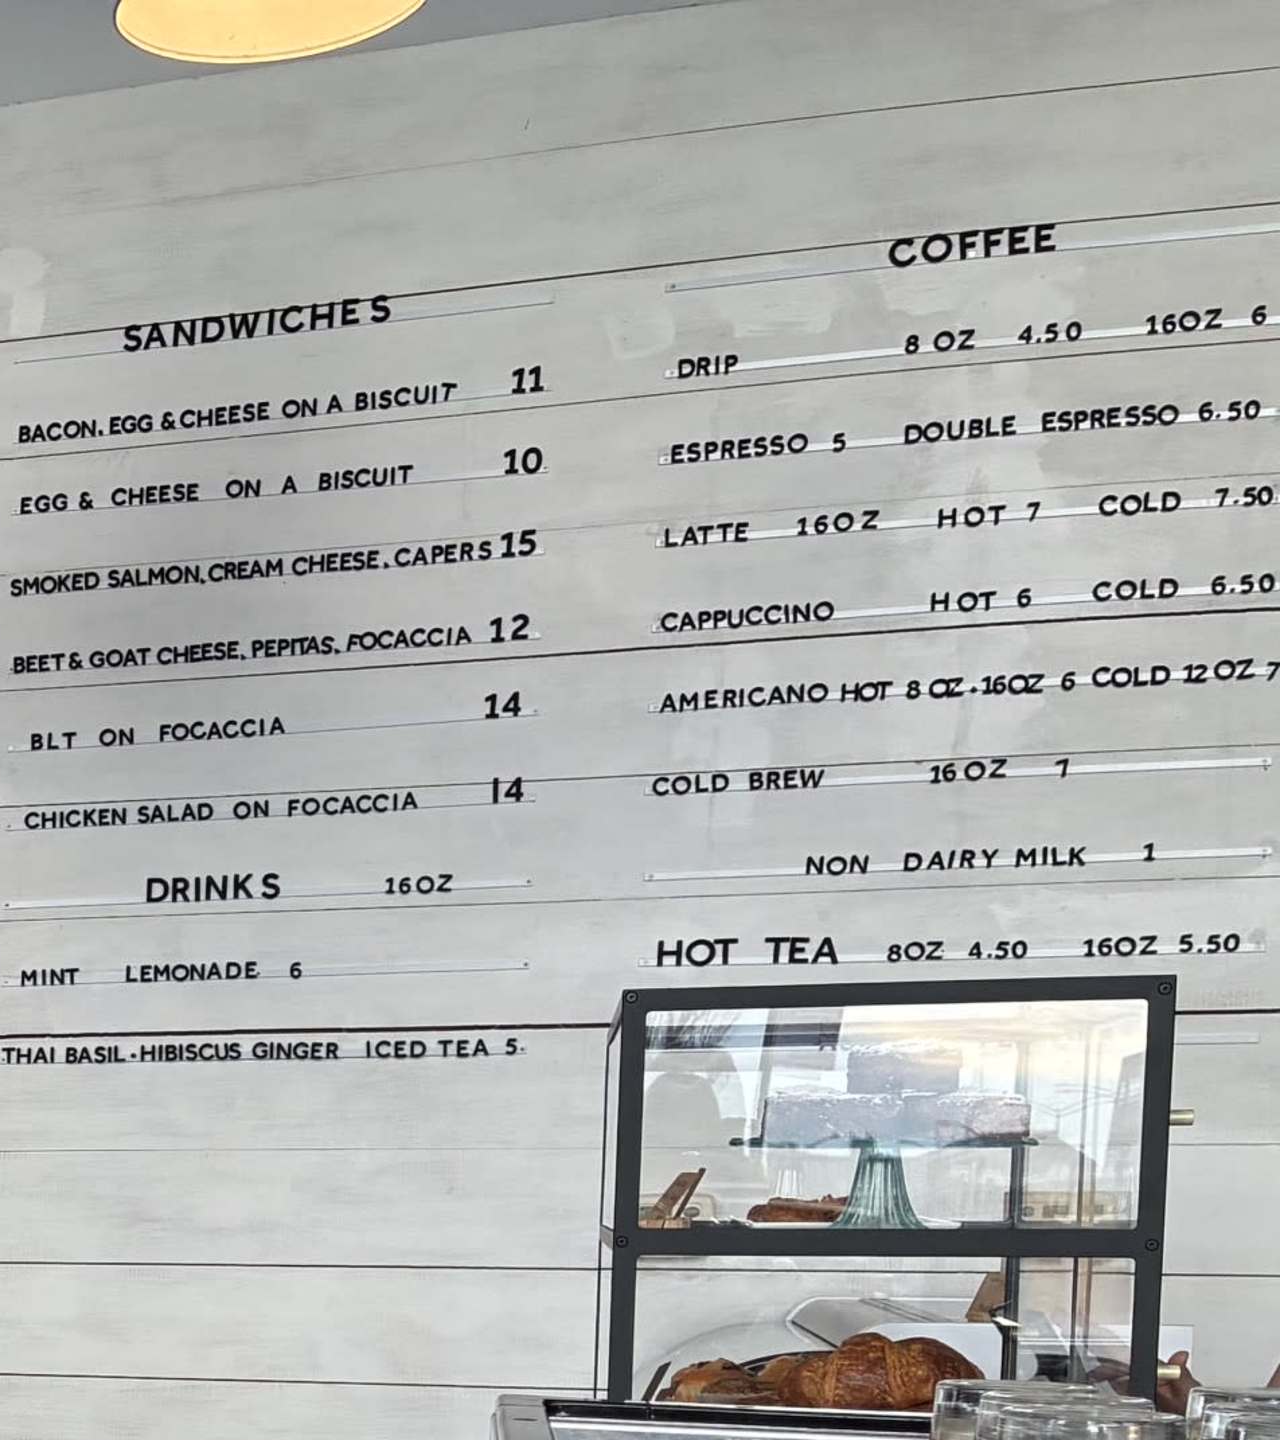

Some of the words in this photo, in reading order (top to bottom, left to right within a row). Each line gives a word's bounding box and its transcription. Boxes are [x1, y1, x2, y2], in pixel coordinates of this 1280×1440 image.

[888, 223, 1058, 268] COFFEE
[123, 294, 392, 353] SANDWICHES
[677, 354, 739, 379] DRIP
[1018, 321, 1082, 345] 4.50
[1251, 304, 1267, 326] 6
[109, 413, 153, 436] EGG
[179, 401, 270, 429] CHEESE
[281, 397, 318, 419] ON
[326, 394, 343, 415] A
[354, 382, 458, 412] BISCUIT
[511, 365, 544, 395] 11
[670, 433, 809, 465] ESPRESSO
[832, 432, 846, 453] 5
[904, 415, 1017, 445] DOUBLE
[1041, 404, 1180, 433] ESPRESSO
[1198, 399, 1261, 423] 6.50
[19, 493, 68, 515] EGG
[110, 482, 199, 507] CHEESE
[225, 479, 262, 499] ON
[280, 475, 298, 495] A
[318, 464, 414, 492] BISCUIT
[503, 447, 543, 475] 10
[664, 522, 749, 548] LATTE
[937, 504, 1007, 529] HOT
[1027, 501, 1041, 522] 7
[1098, 491, 1181, 517] COLD
[1215, 485, 1274, 508] 7.50
[10, 571, 101, 598] SMOKED
[394, 540, 492, 568] CAPERS
[500, 529, 537, 559] 15
[660, 600, 835, 633] CAPPUCCINO
[930, 590, 997, 613] HOT
[1017, 588, 1032, 608] 6
[1092, 578, 1179, 603] COLD
[1211, 573, 1275, 596] 6.50
[88, 647, 152, 669] GOAT
[346, 626, 472, 653] FOCACCIA
[489, 613, 530, 644] 12
[659, 682, 829, 714] AMERICANO
[840, 681, 894, 703] HOT
[1060, 671, 1076, 692] 6
[1091, 665, 1171, 688] COLD
[30, 731, 77, 751] BLT
[98, 727, 135, 747] ON
[159, 716, 285, 743] FOCACCIA
[484, 691, 522, 720] 14
[24, 807, 127, 830] CHICKEN
[137, 802, 214, 825] SALAD
[232, 799, 269, 820] ON
[286, 791, 418, 817] FOCACCIA
[492, 776, 524, 805] 14
[652, 773, 730, 797] COLD
[749, 769, 825, 791] BREW
[1055, 758, 1069, 778] 7
[805, 855, 869, 876] NON
[902, 849, 999, 872] DAIRY
[1014, 846, 1086, 868] MILK
[1143, 842, 1156, 862] 1
[146, 872, 281, 903] DRINKS
[21, 967, 80, 987] MINT
[125, 961, 258, 983] LEMONADE
[289, 961, 302, 980] 6
[656, 938, 739, 967] HOT
[764, 936, 839, 965] TEA
[968, 940, 1028, 960] 4.50
[1179, 933, 1240, 954] 5.50
[2, 1046, 55, 1065] THAI
[252, 1041, 340, 1061] GINGER
[366, 1040, 427, 1059] ICED
[437, 1038, 489, 1058] TEA
[505, 1038, 518, 1056] 5
